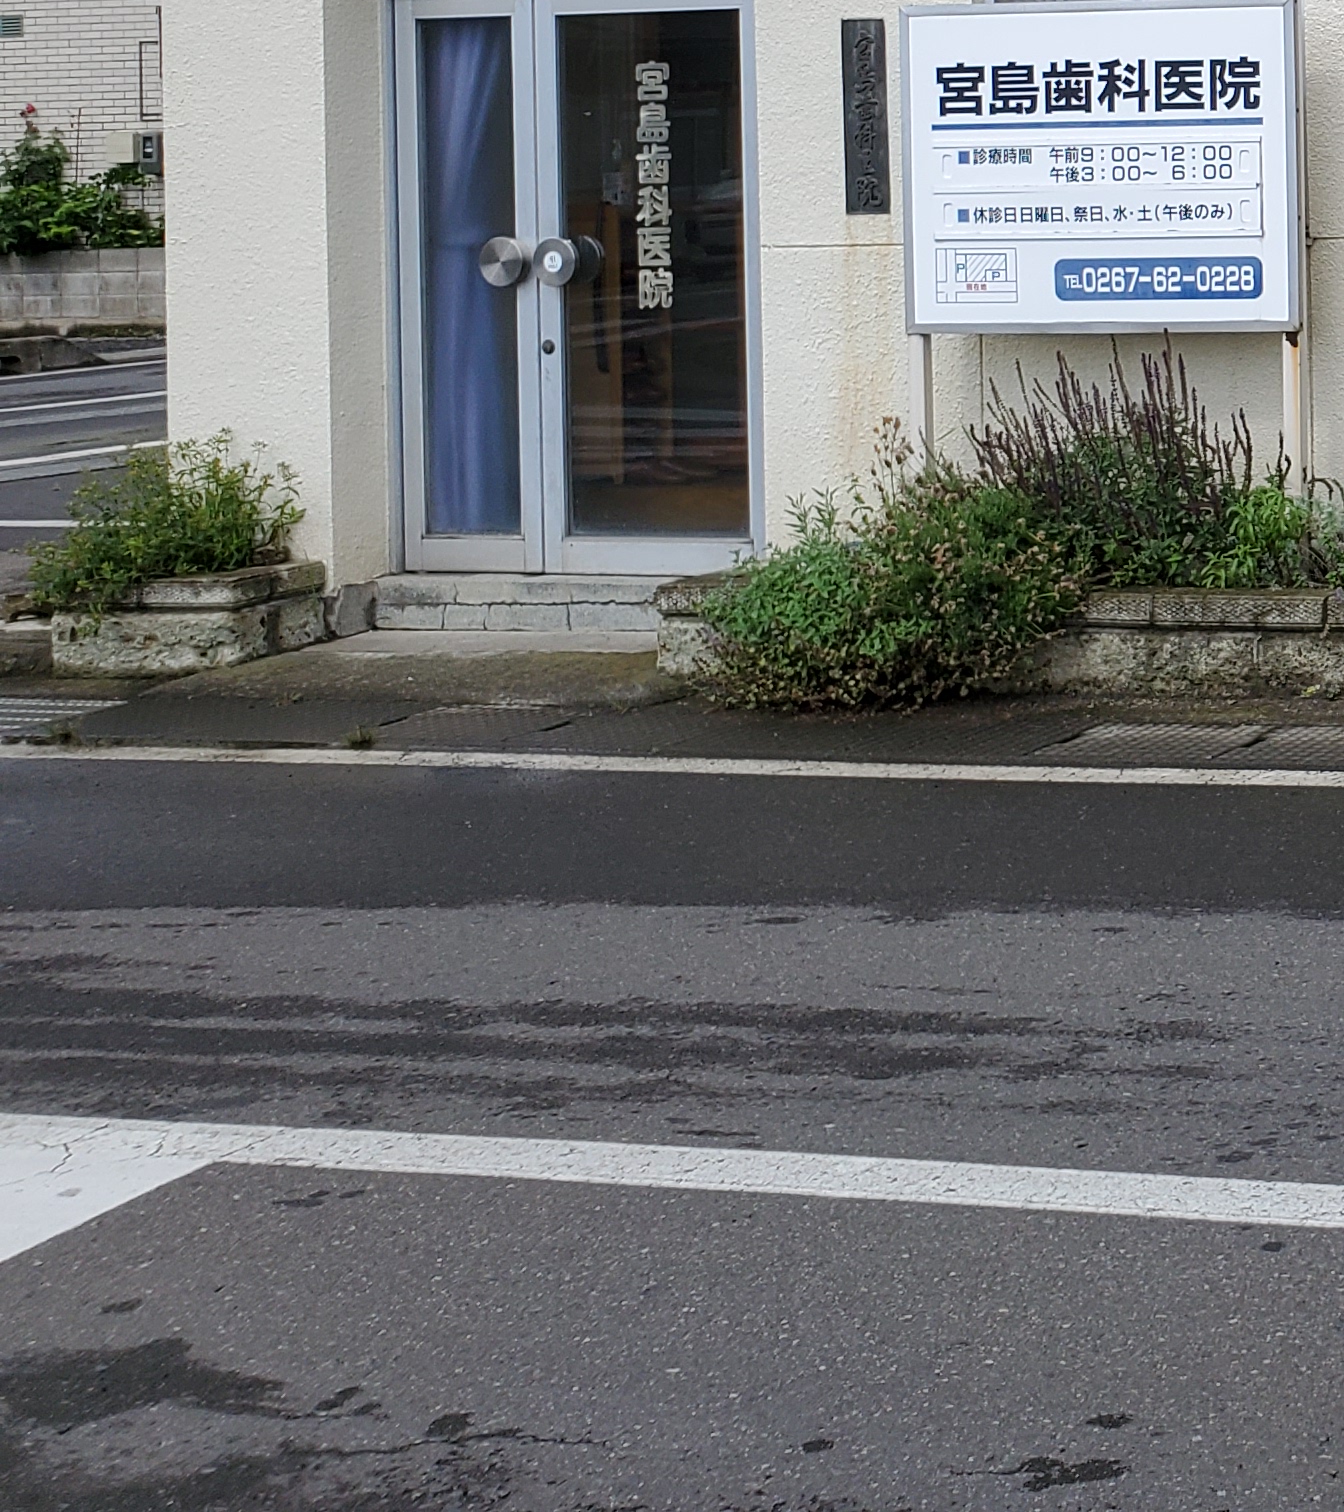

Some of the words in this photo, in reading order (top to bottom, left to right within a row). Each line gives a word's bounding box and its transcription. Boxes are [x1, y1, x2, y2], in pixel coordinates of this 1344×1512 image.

[936, 56, 1260, 116] 宮島歯科医院
[973, 148, 1032, 165] 診療時間
[635, 61, 673, 309] 宮島歯科医院
[956, 263, 965, 273] P
[992, 271, 1001, 280] P
